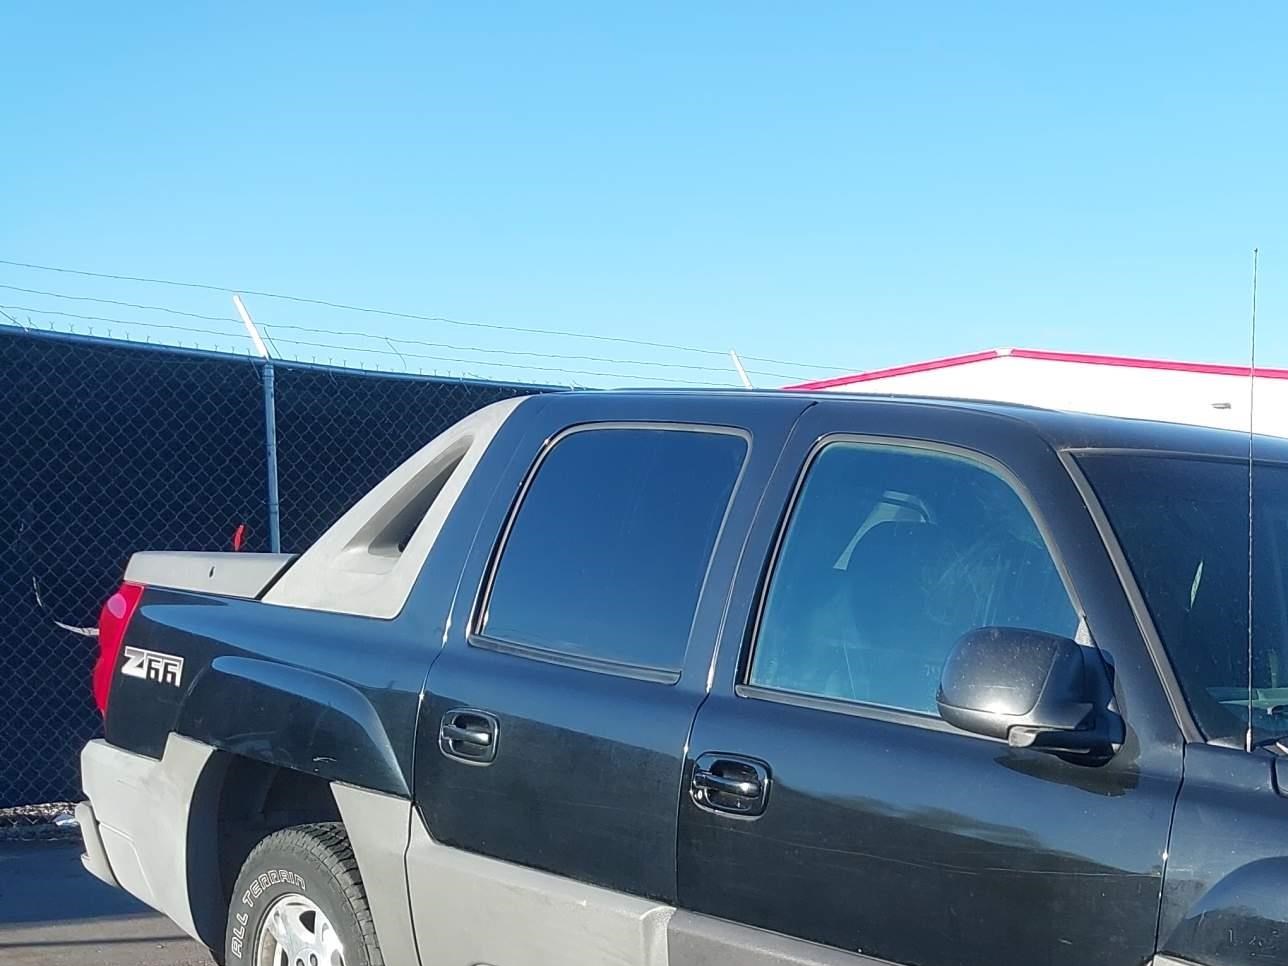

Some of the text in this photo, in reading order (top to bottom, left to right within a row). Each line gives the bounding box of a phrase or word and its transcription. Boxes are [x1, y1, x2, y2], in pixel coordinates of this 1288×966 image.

[121, 645, 185, 688] Z66
[231, 869, 306, 959] ALL TERRAIN
